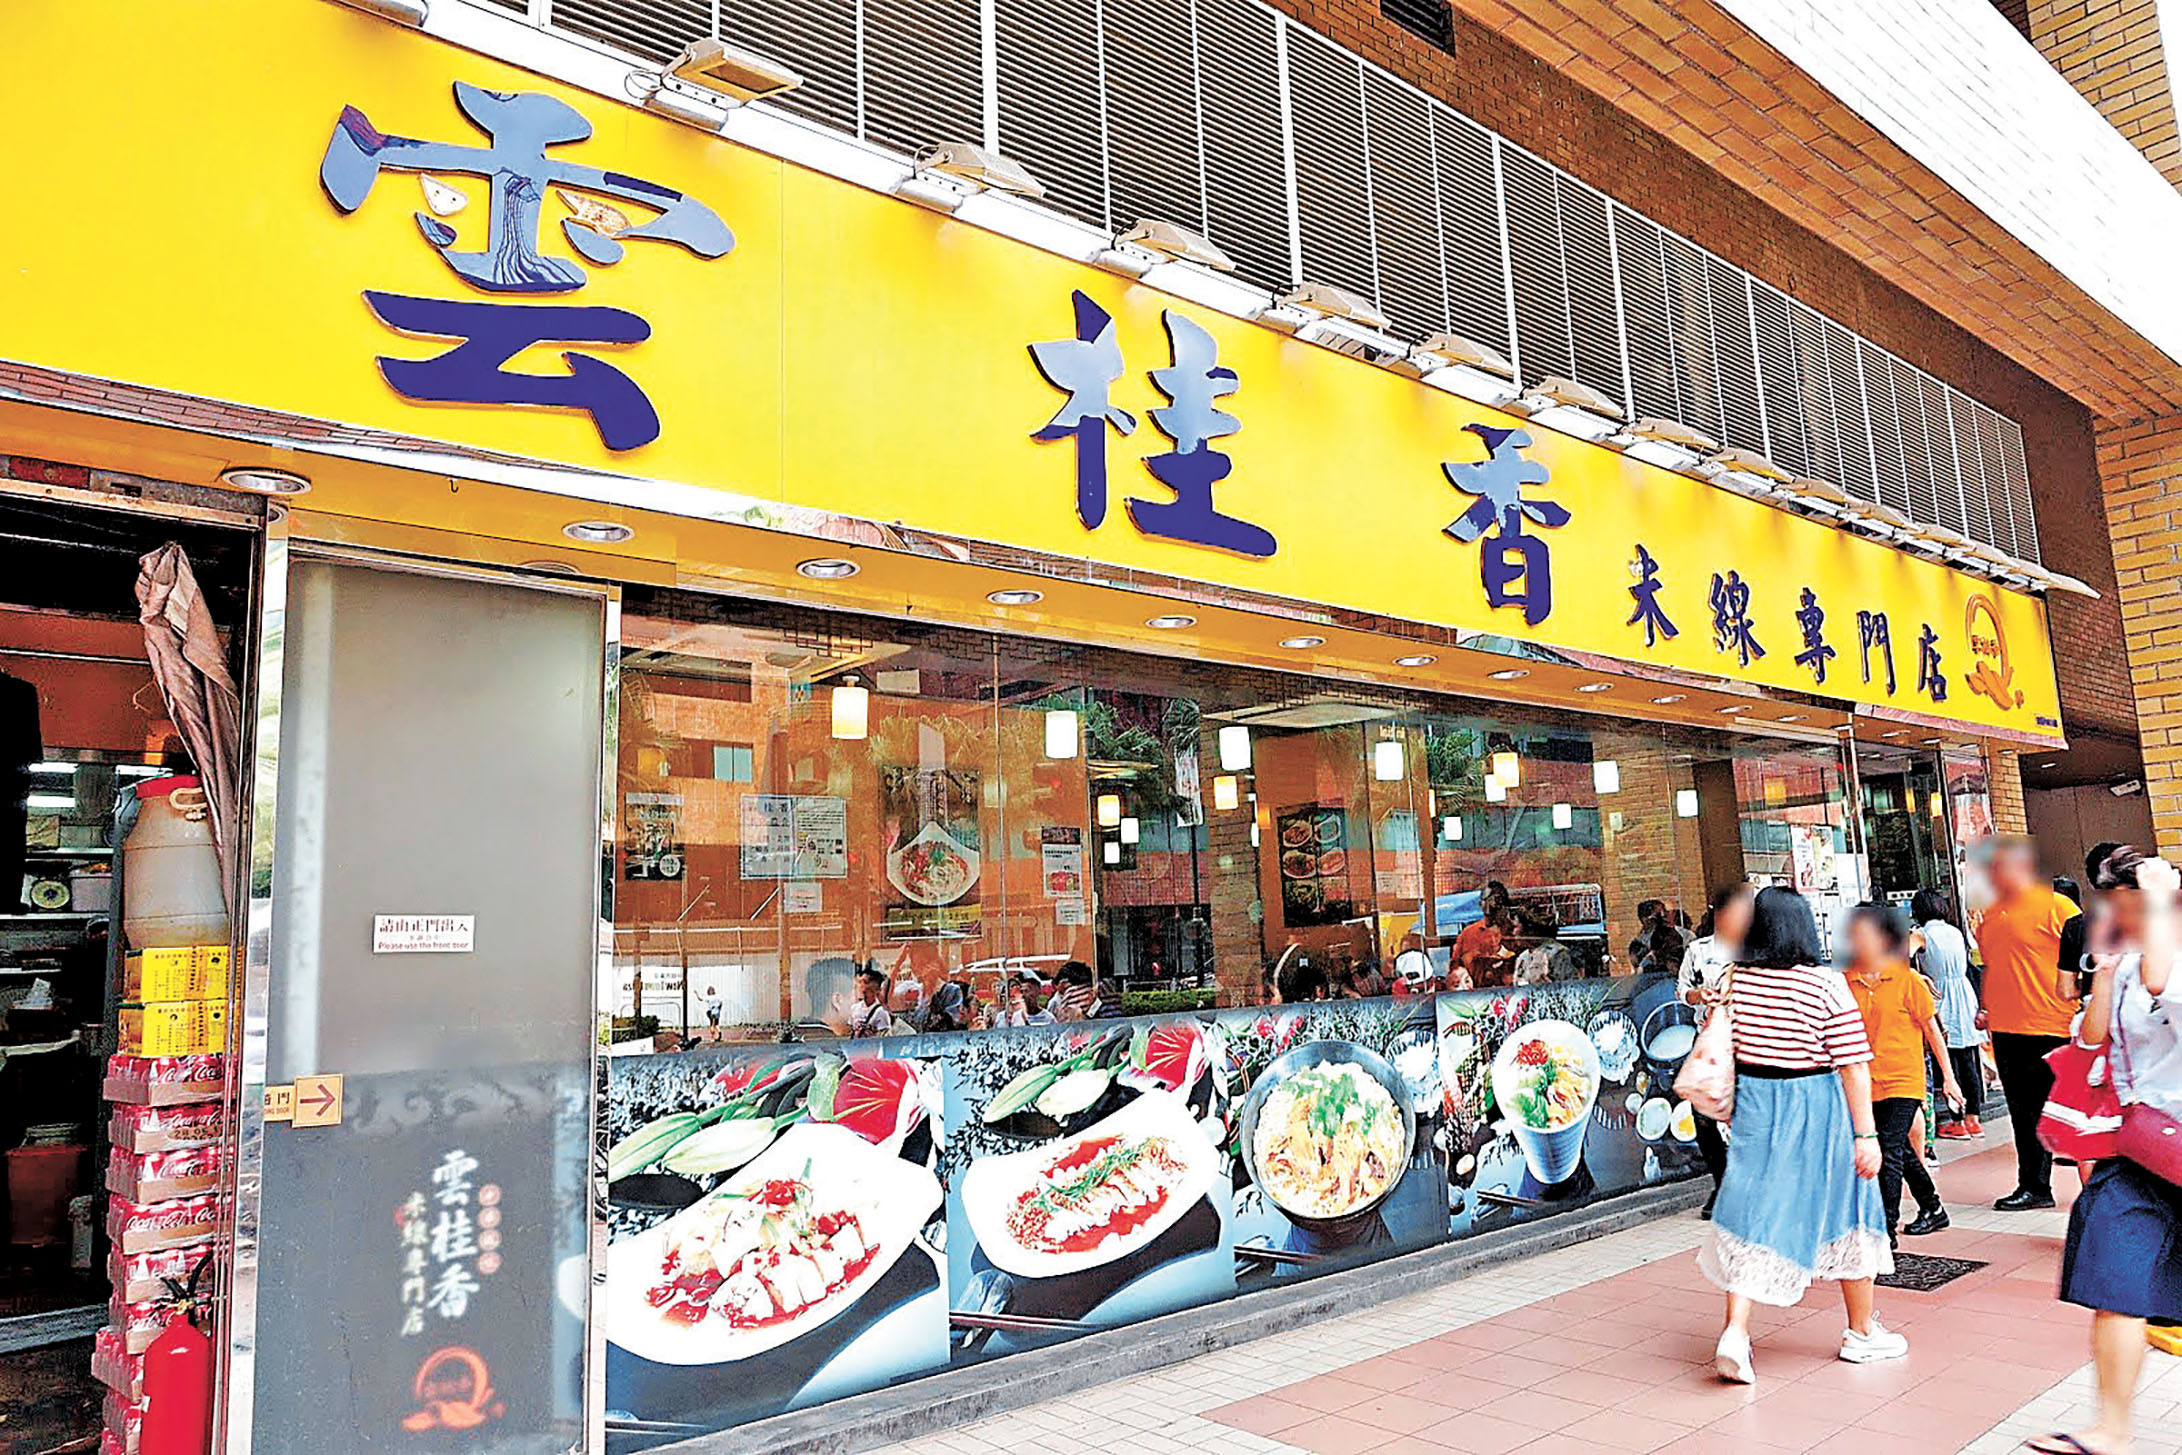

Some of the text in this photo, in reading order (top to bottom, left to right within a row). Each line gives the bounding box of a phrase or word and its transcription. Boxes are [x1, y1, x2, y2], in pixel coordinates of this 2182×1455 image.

[320, 80, 1571, 626] 雲桂香
[1626, 543, 1947, 703] 米線專門店
[378, 941, 402, 950] Please
[419, 941, 431, 949] the
[427, 1149, 481, 1319] 雲桂香
